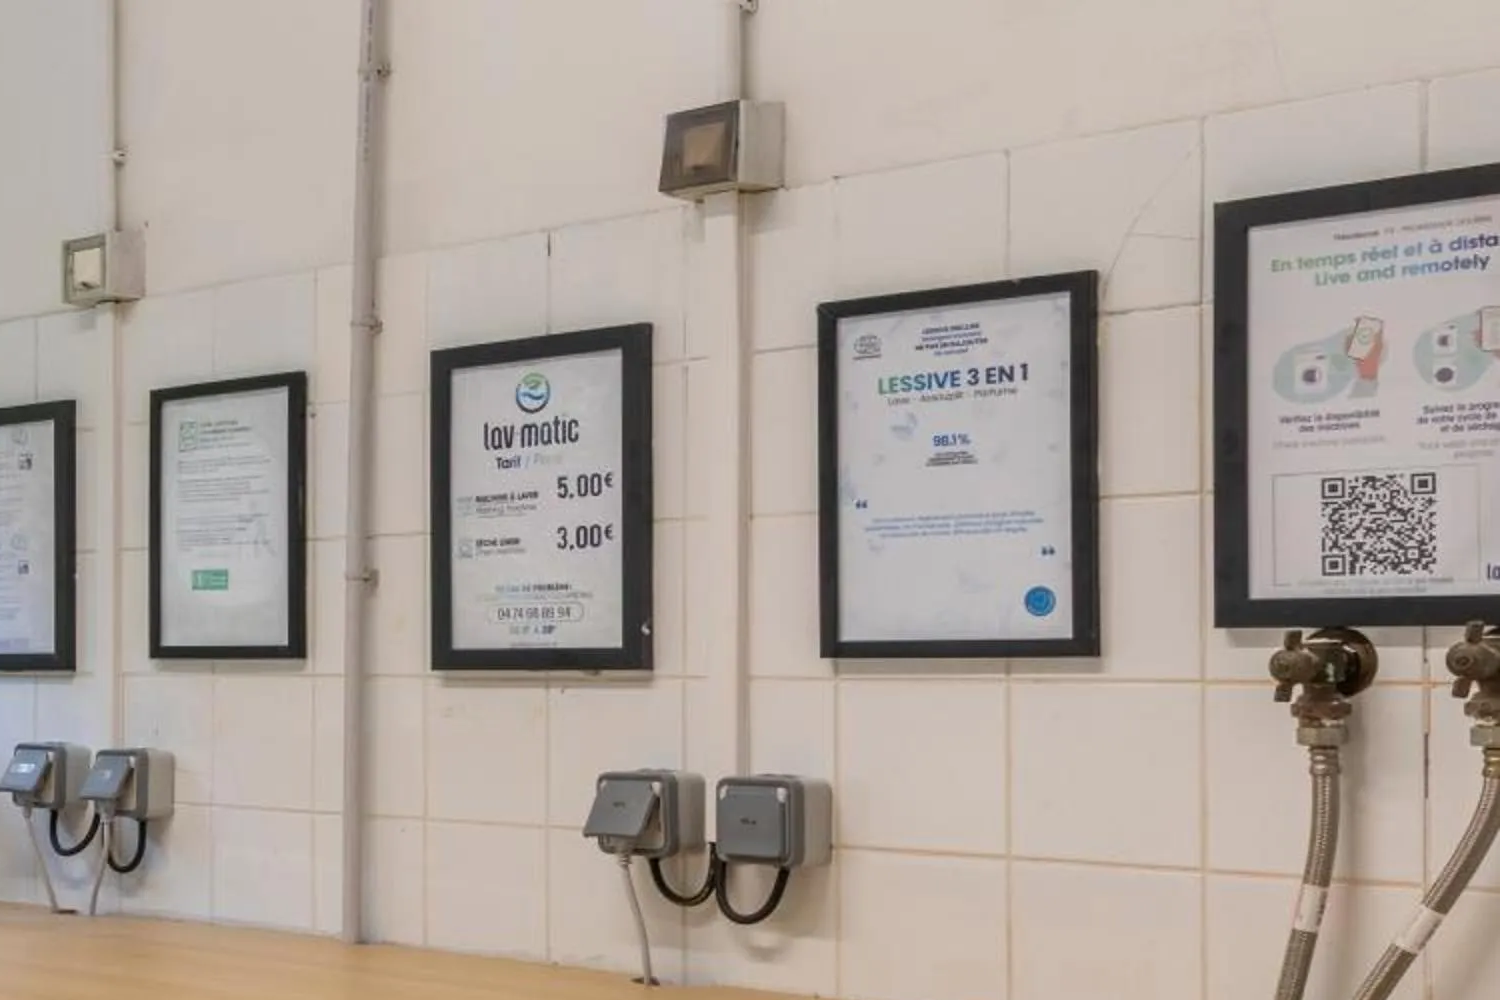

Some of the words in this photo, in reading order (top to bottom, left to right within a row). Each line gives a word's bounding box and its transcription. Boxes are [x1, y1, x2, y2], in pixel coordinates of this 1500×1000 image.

[1297, 252, 1357, 271] temps
[1315, 272, 1350, 287] Live
[1357, 264, 1395, 282] and
[1401, 253, 1491, 277] remotely
[878, 370, 961, 395] LESSIVE
[967, 368, 979, 386] 3
[986, 364, 1014, 385] EN
[1020, 362, 1028, 381] 1
